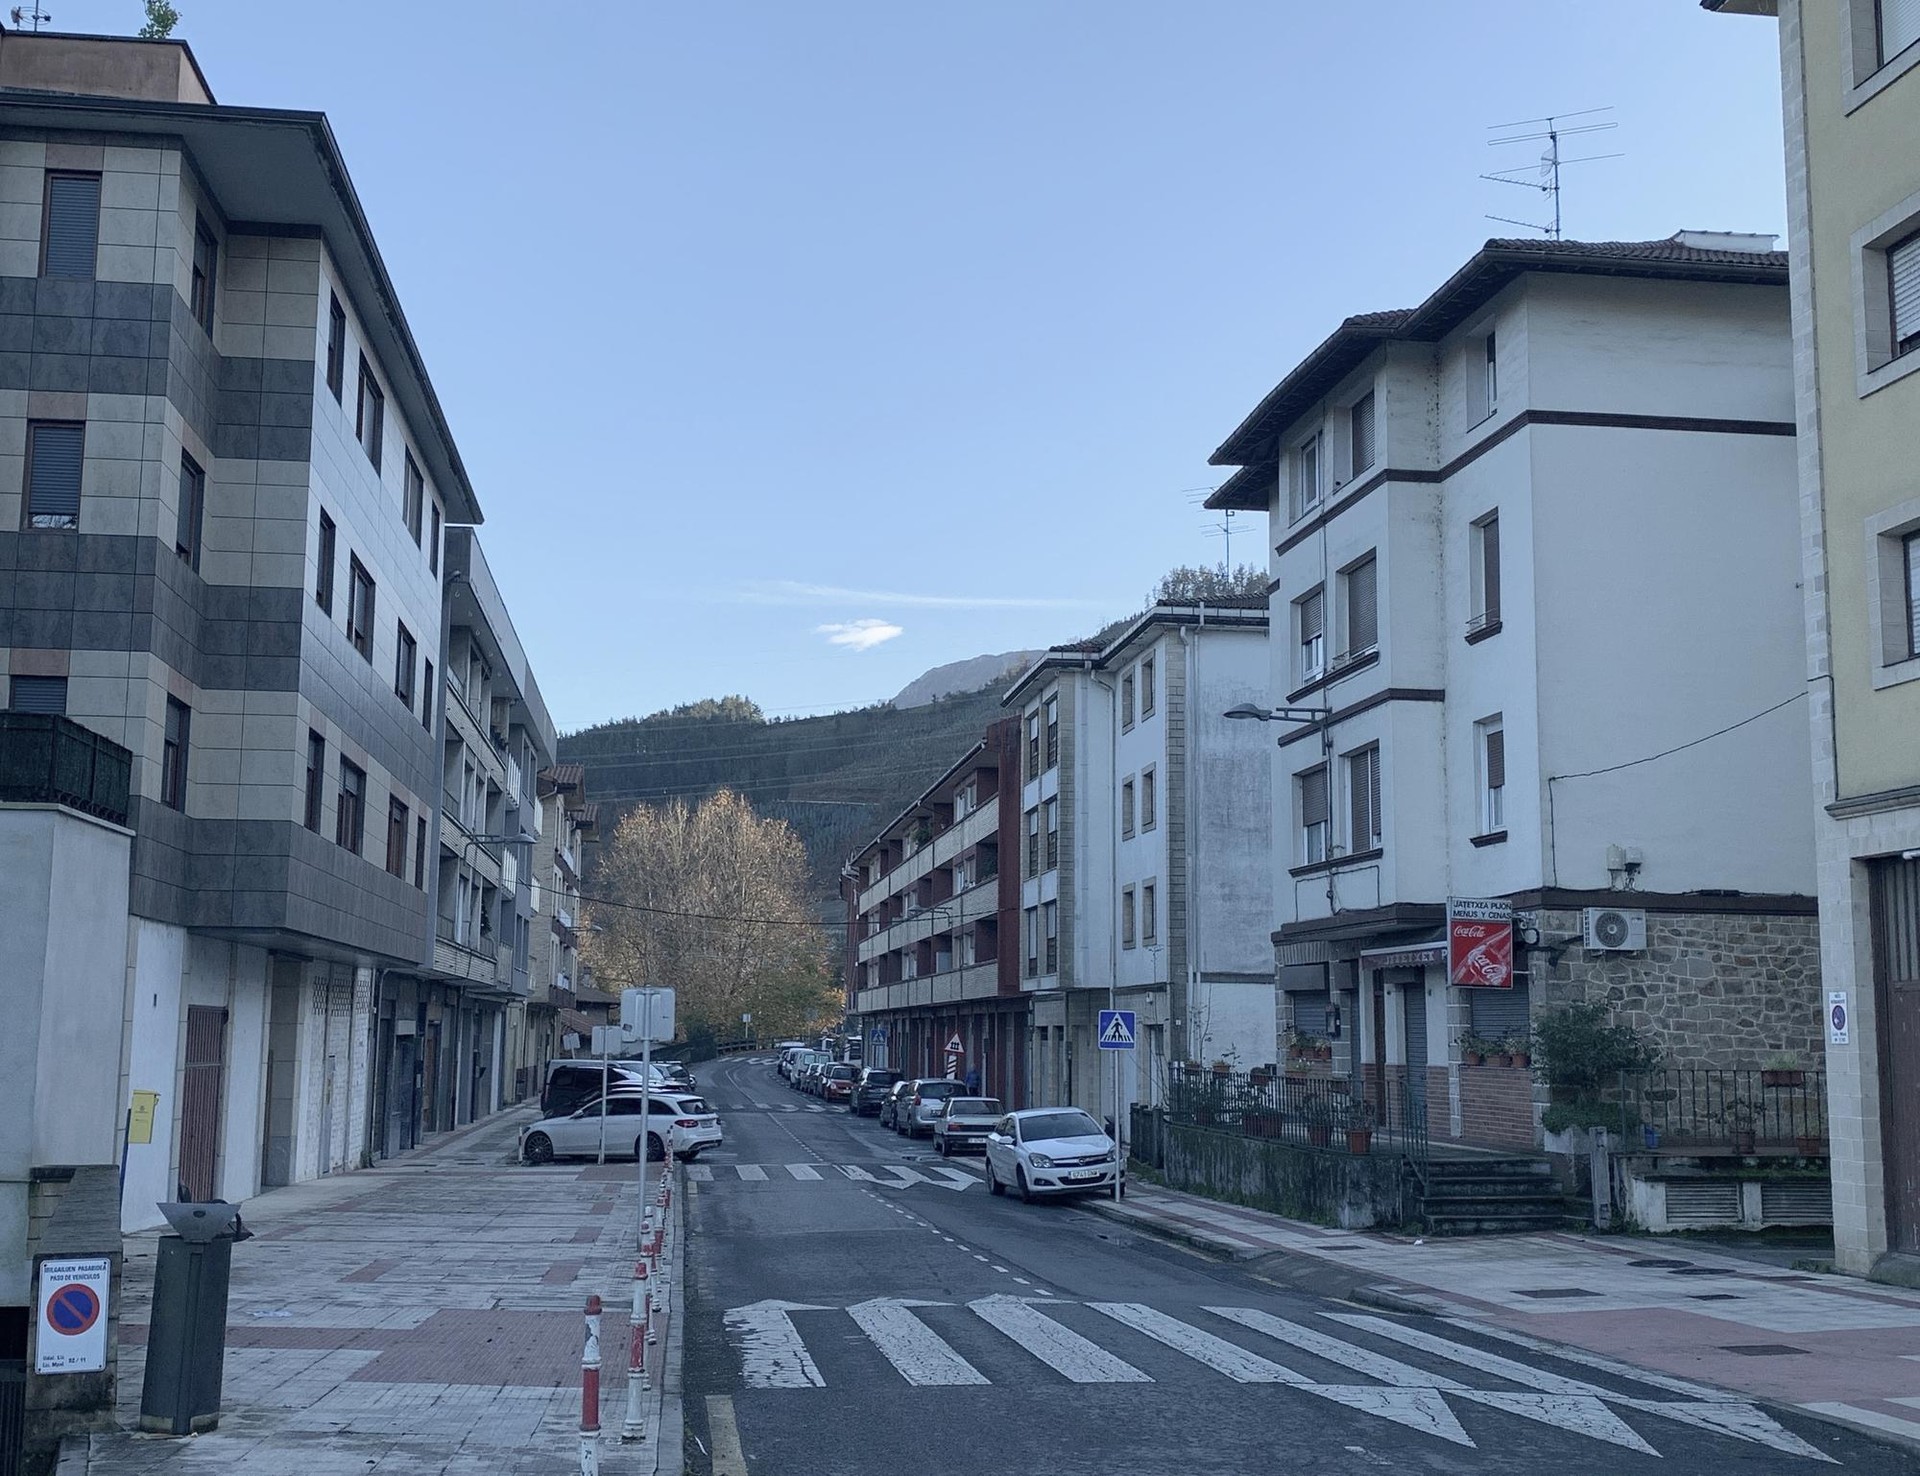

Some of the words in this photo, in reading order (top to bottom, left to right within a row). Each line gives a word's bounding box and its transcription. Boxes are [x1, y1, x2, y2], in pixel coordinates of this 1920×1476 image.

[1453, 900, 1489, 910] JATETXEA
[1453, 910, 1478, 918] MENUS
[1481, 911, 1486, 919] Y
[1488, 911, 1512, 920] CENAS
